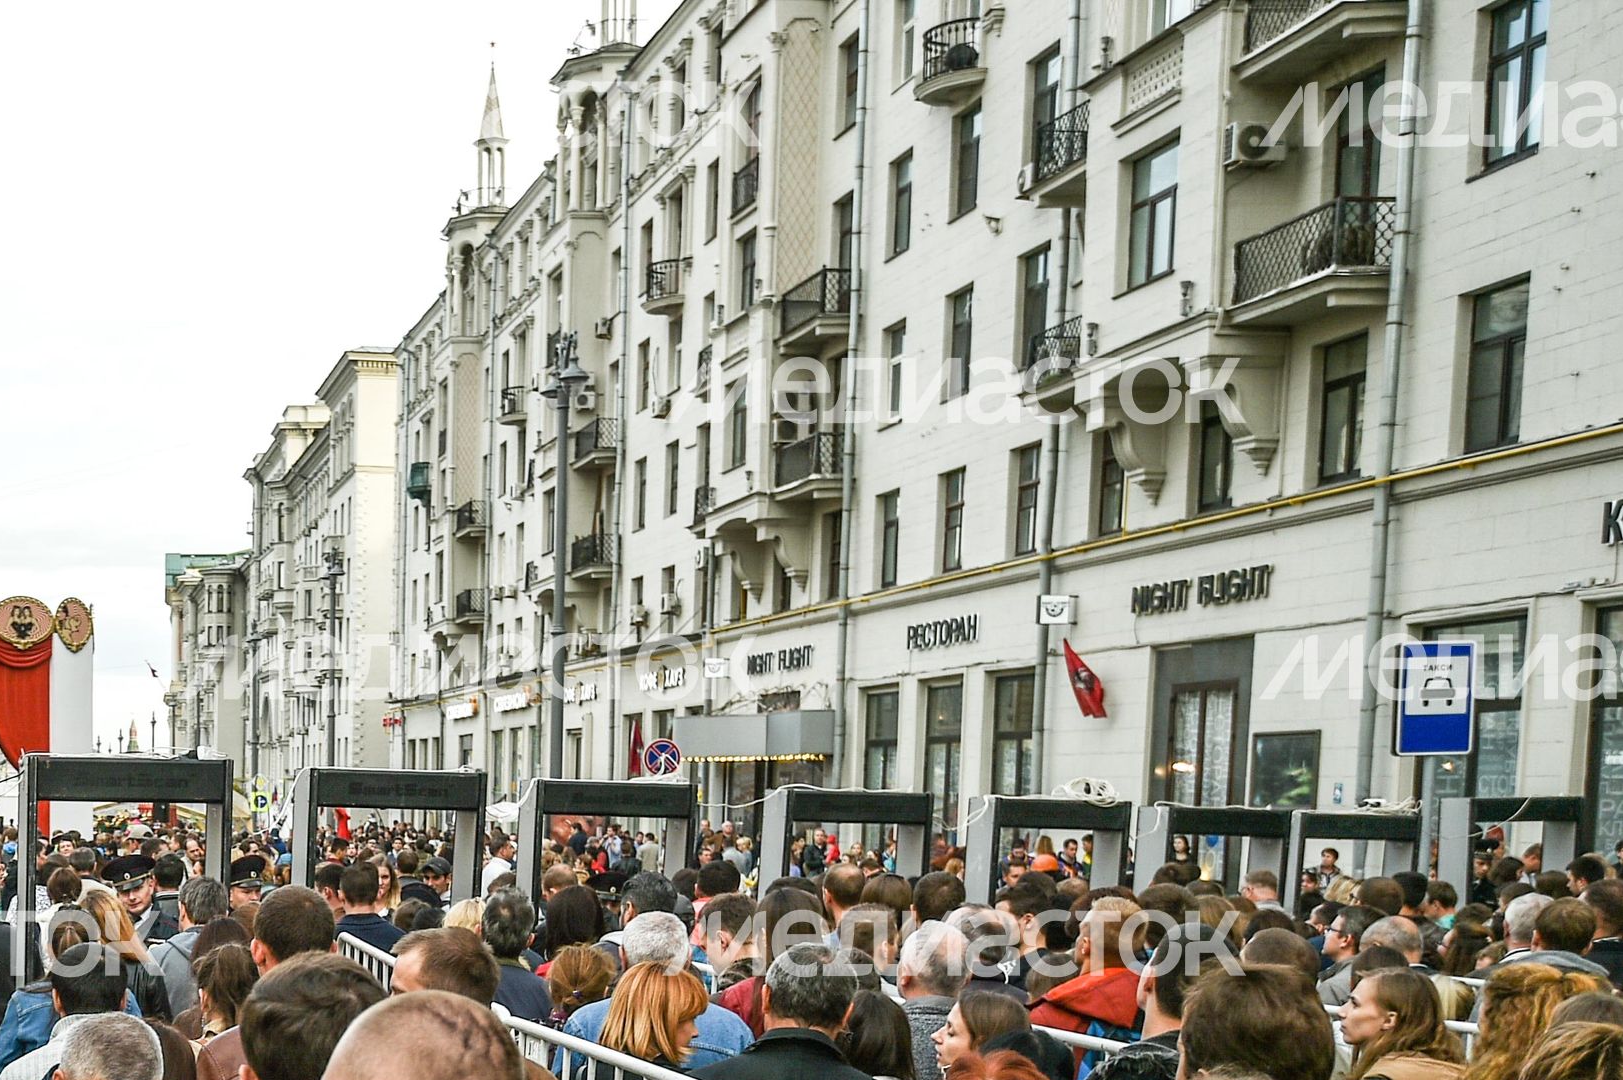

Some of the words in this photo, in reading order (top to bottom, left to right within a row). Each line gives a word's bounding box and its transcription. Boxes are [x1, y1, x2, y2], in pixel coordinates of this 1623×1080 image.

[1131, 579, 1192, 616] NIGHT
[1197, 564, 1274, 607] FLIGHT
[907, 613, 980, 651] РЕСТОРАН
[747, 652, 775, 677] NIGHT
[778, 645, 814, 673] FLIGHT
